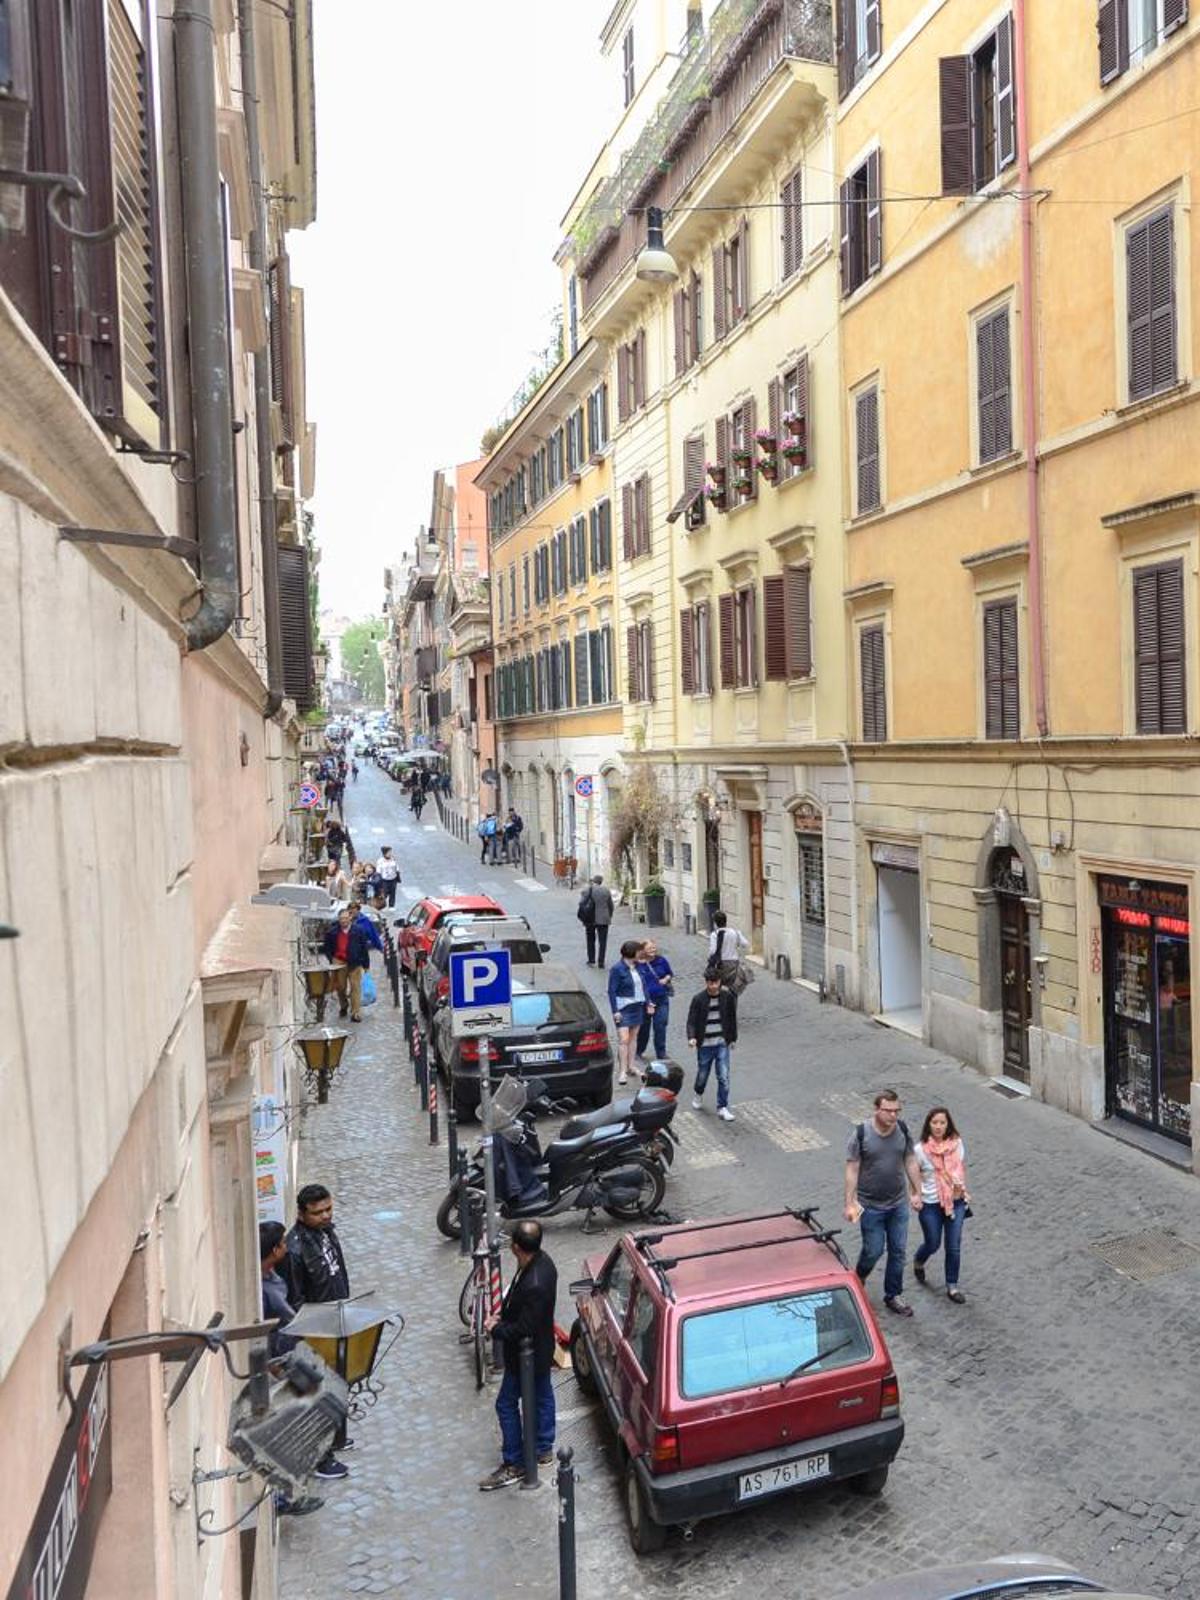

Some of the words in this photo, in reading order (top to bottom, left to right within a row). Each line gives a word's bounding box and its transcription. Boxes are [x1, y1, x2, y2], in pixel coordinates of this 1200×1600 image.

[463, 958, 498, 1003] P
[744, 1473, 763, 1493] AS
[772, 1464, 799, 1485] 761
[807, 1456, 826, 1476] RP
